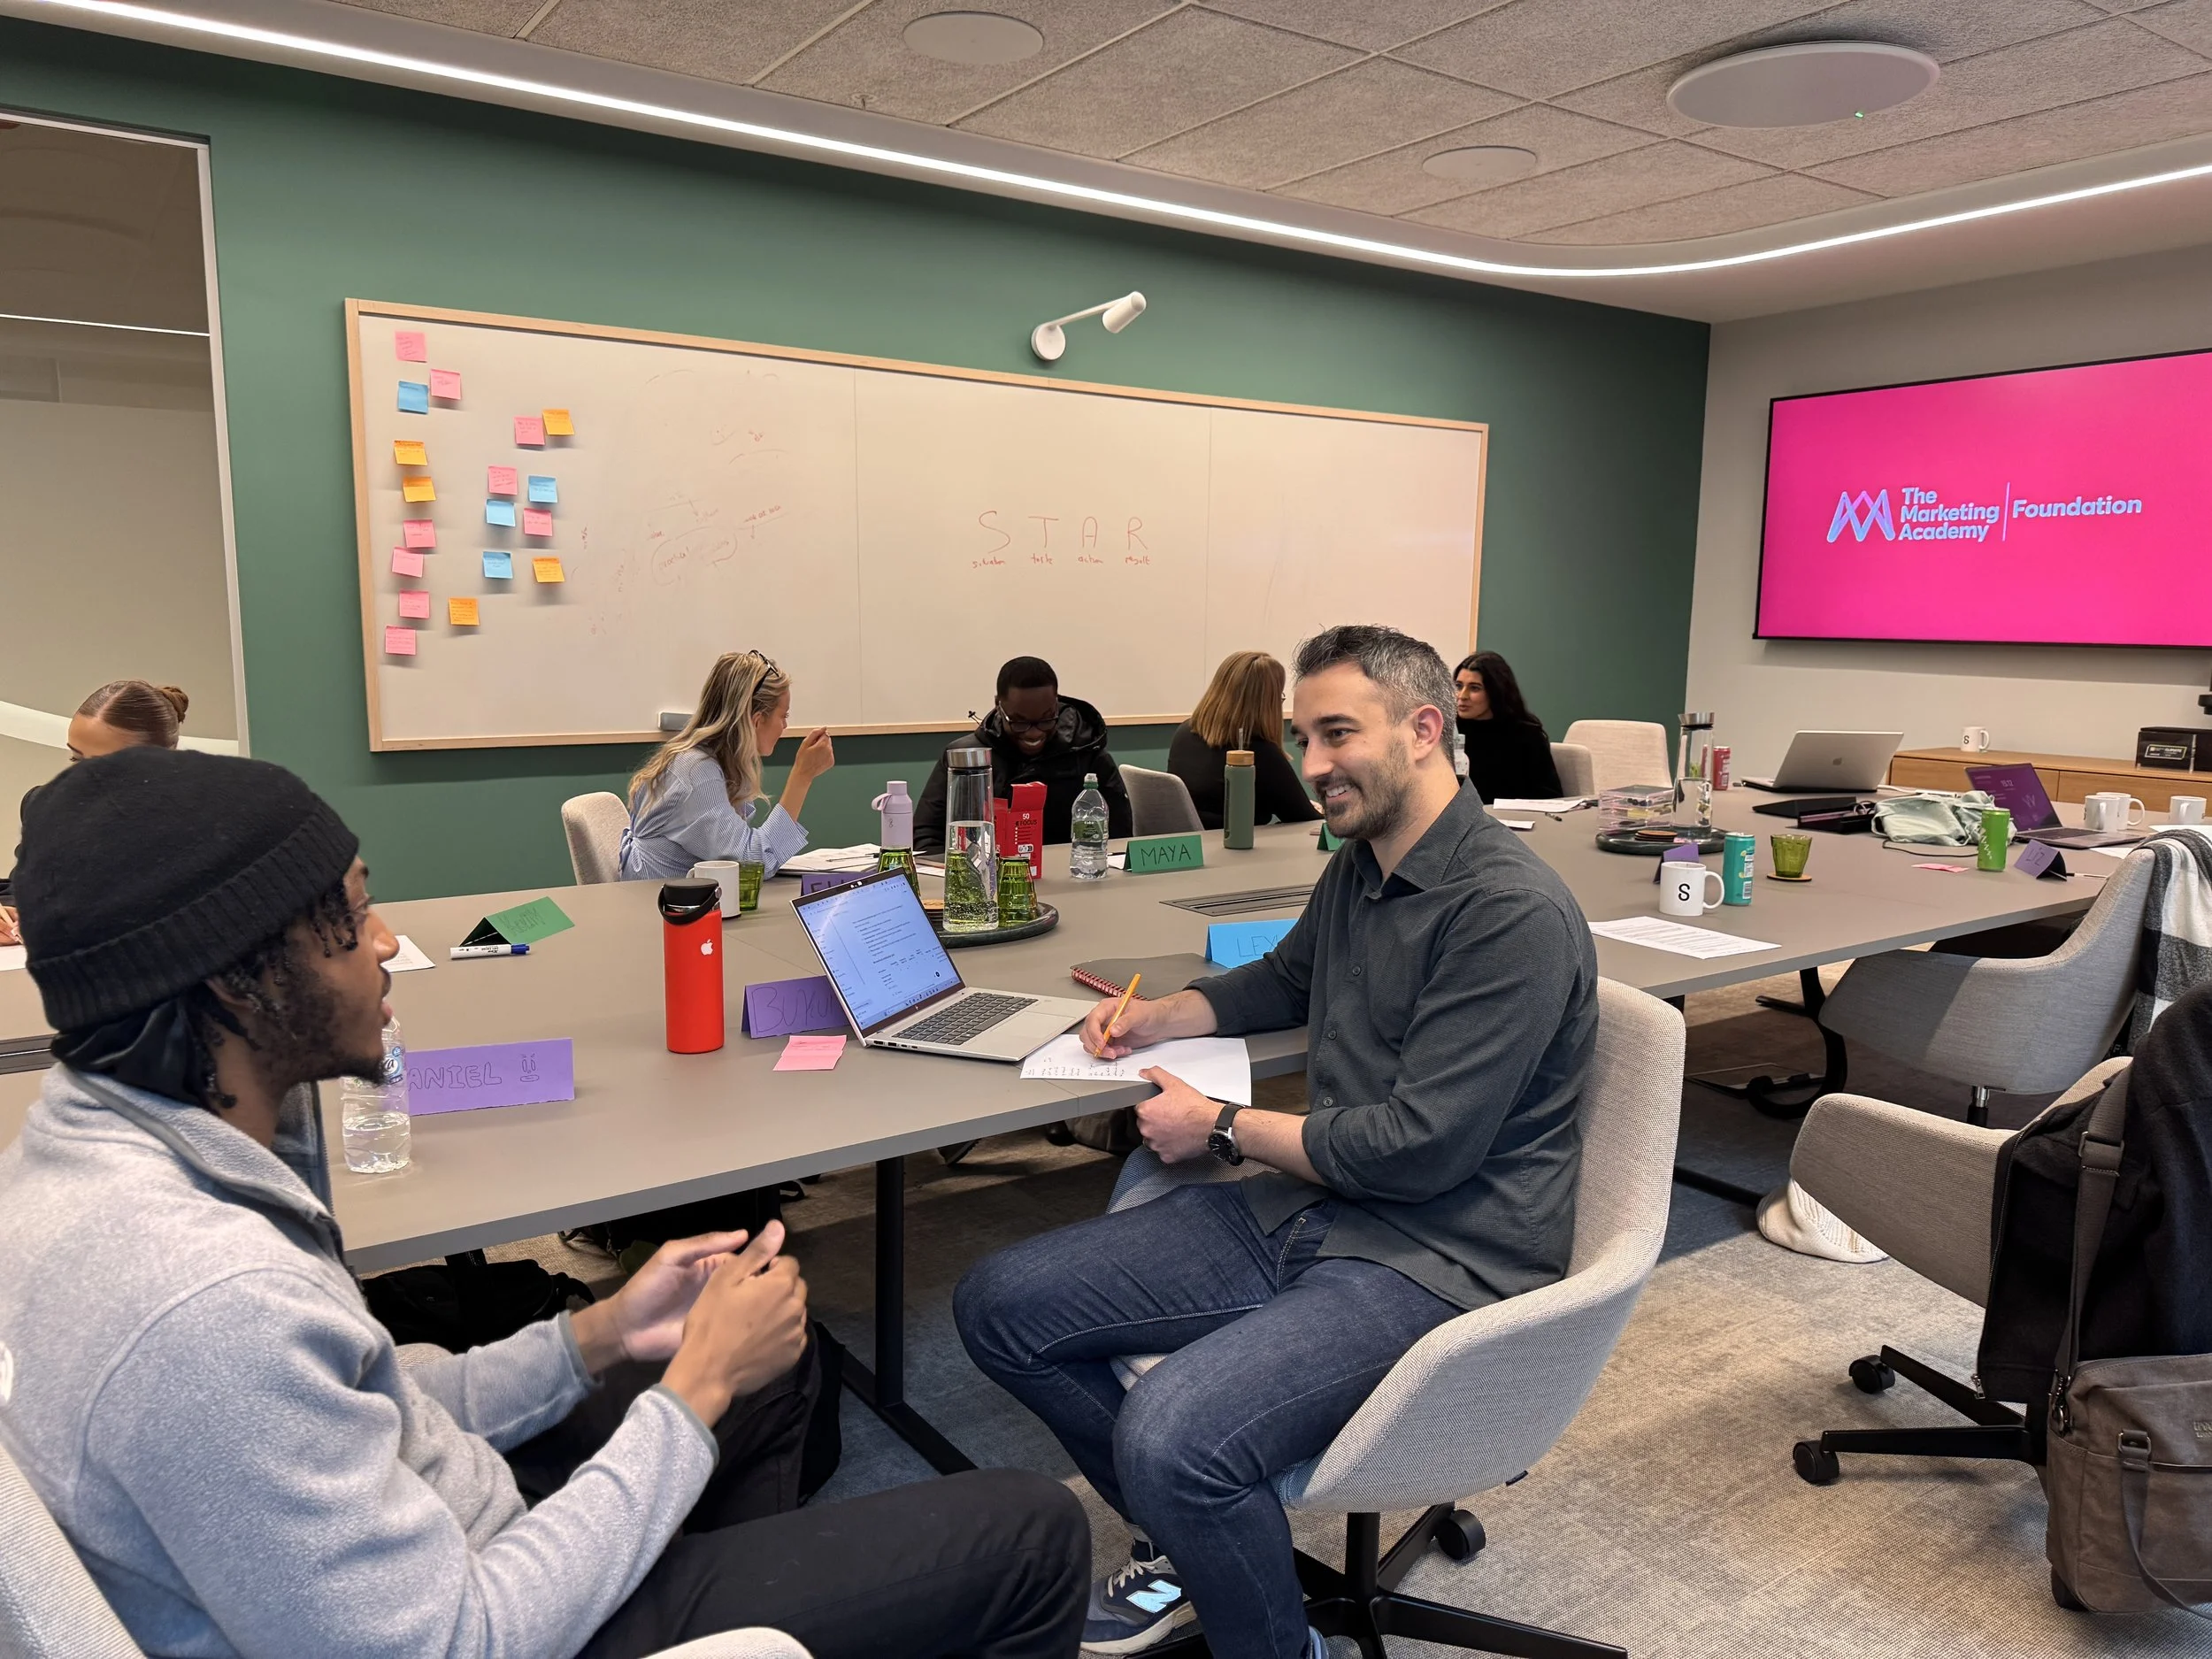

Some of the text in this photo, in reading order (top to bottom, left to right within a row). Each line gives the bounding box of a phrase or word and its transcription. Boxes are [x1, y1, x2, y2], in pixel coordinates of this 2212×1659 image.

[1901, 487, 1937, 504] The
[1900, 503, 2000, 524] Marketing
[2012, 495, 2142, 518] Foundation
[1898, 522, 1990, 542] Academy
[1140, 843, 1192, 866] MAYA
[1678, 883, 1691, 902] S
[407, 1061, 503, 1091] ANIEL
